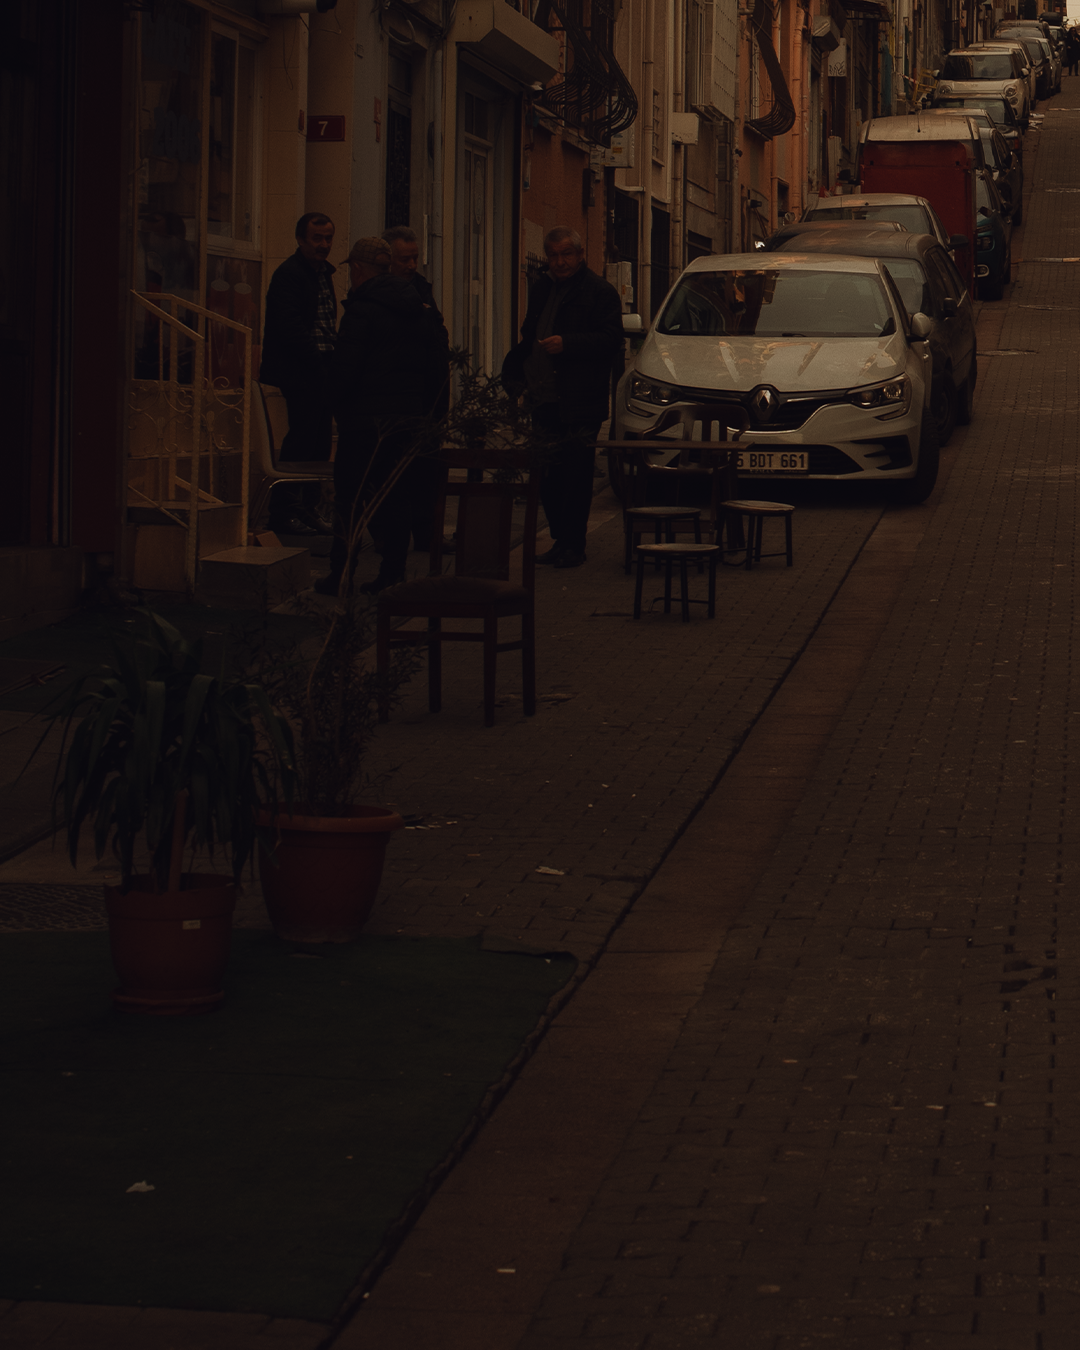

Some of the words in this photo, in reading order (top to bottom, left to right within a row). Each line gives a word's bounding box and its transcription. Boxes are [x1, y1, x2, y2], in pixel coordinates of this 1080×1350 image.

[318, 120, 328, 136] 7
[750, 453, 774, 467] BDT
[781, 454, 804, 468] 661
